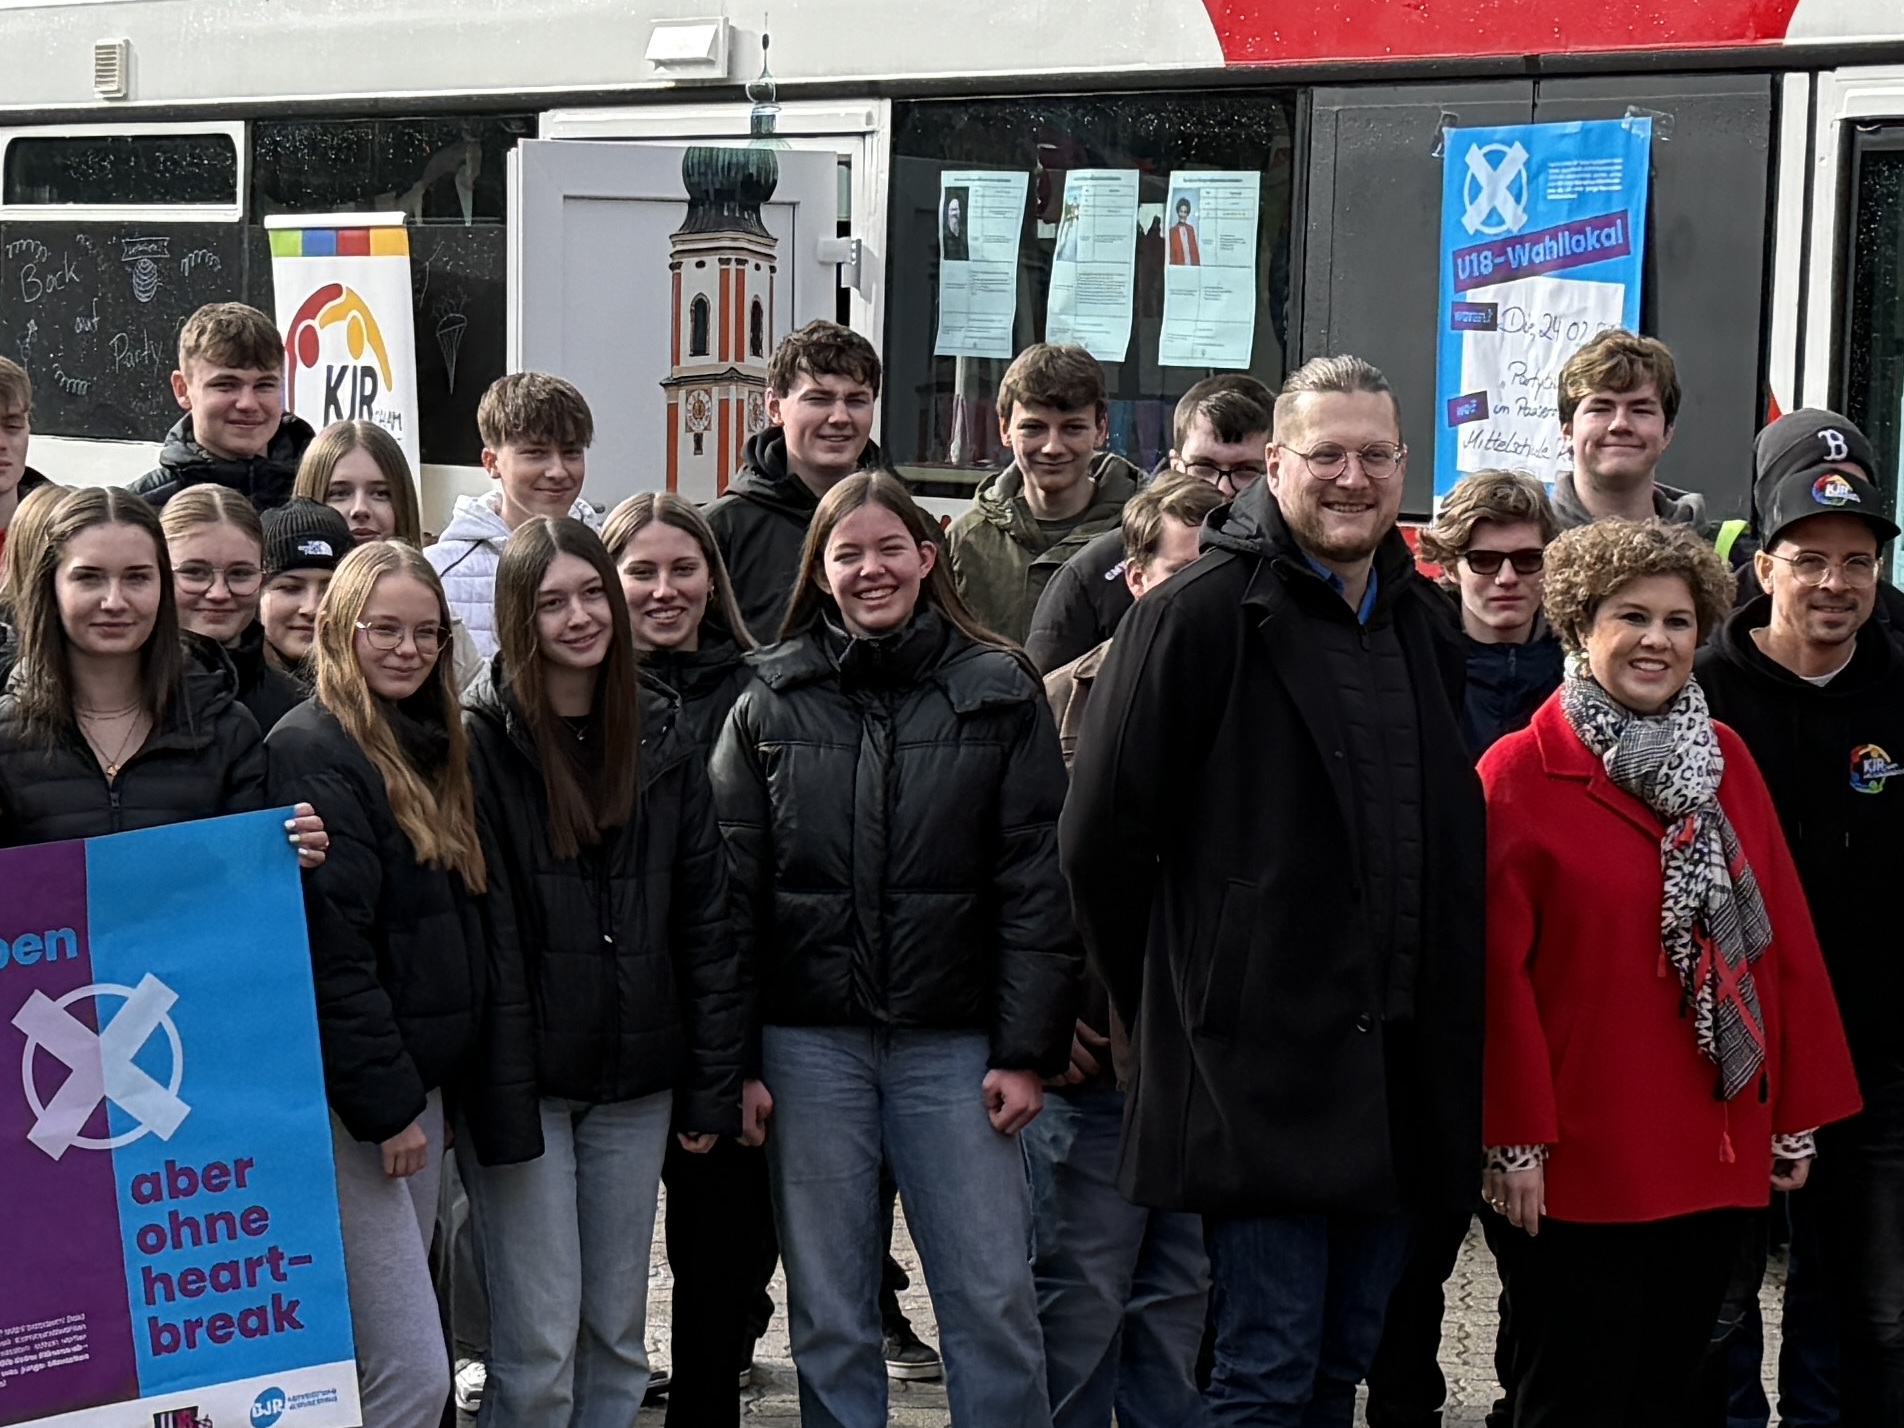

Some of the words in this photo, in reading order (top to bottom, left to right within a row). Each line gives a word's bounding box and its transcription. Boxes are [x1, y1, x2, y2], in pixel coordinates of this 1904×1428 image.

[1457, 219, 1623, 279] U18-Wahllokal
[108, 328, 163, 374] Party
[324, 365, 378, 427] KJR
[1817, 429, 1848, 461] B
[1863, 758, 1886, 773] KJR
[130, 1154, 255, 1205] aber
[135, 1203, 270, 1256] ohne
[142, 1245, 314, 1306] heart-
[148, 1293, 304, 1358] break
[251, 1398, 285, 1419] BJR
